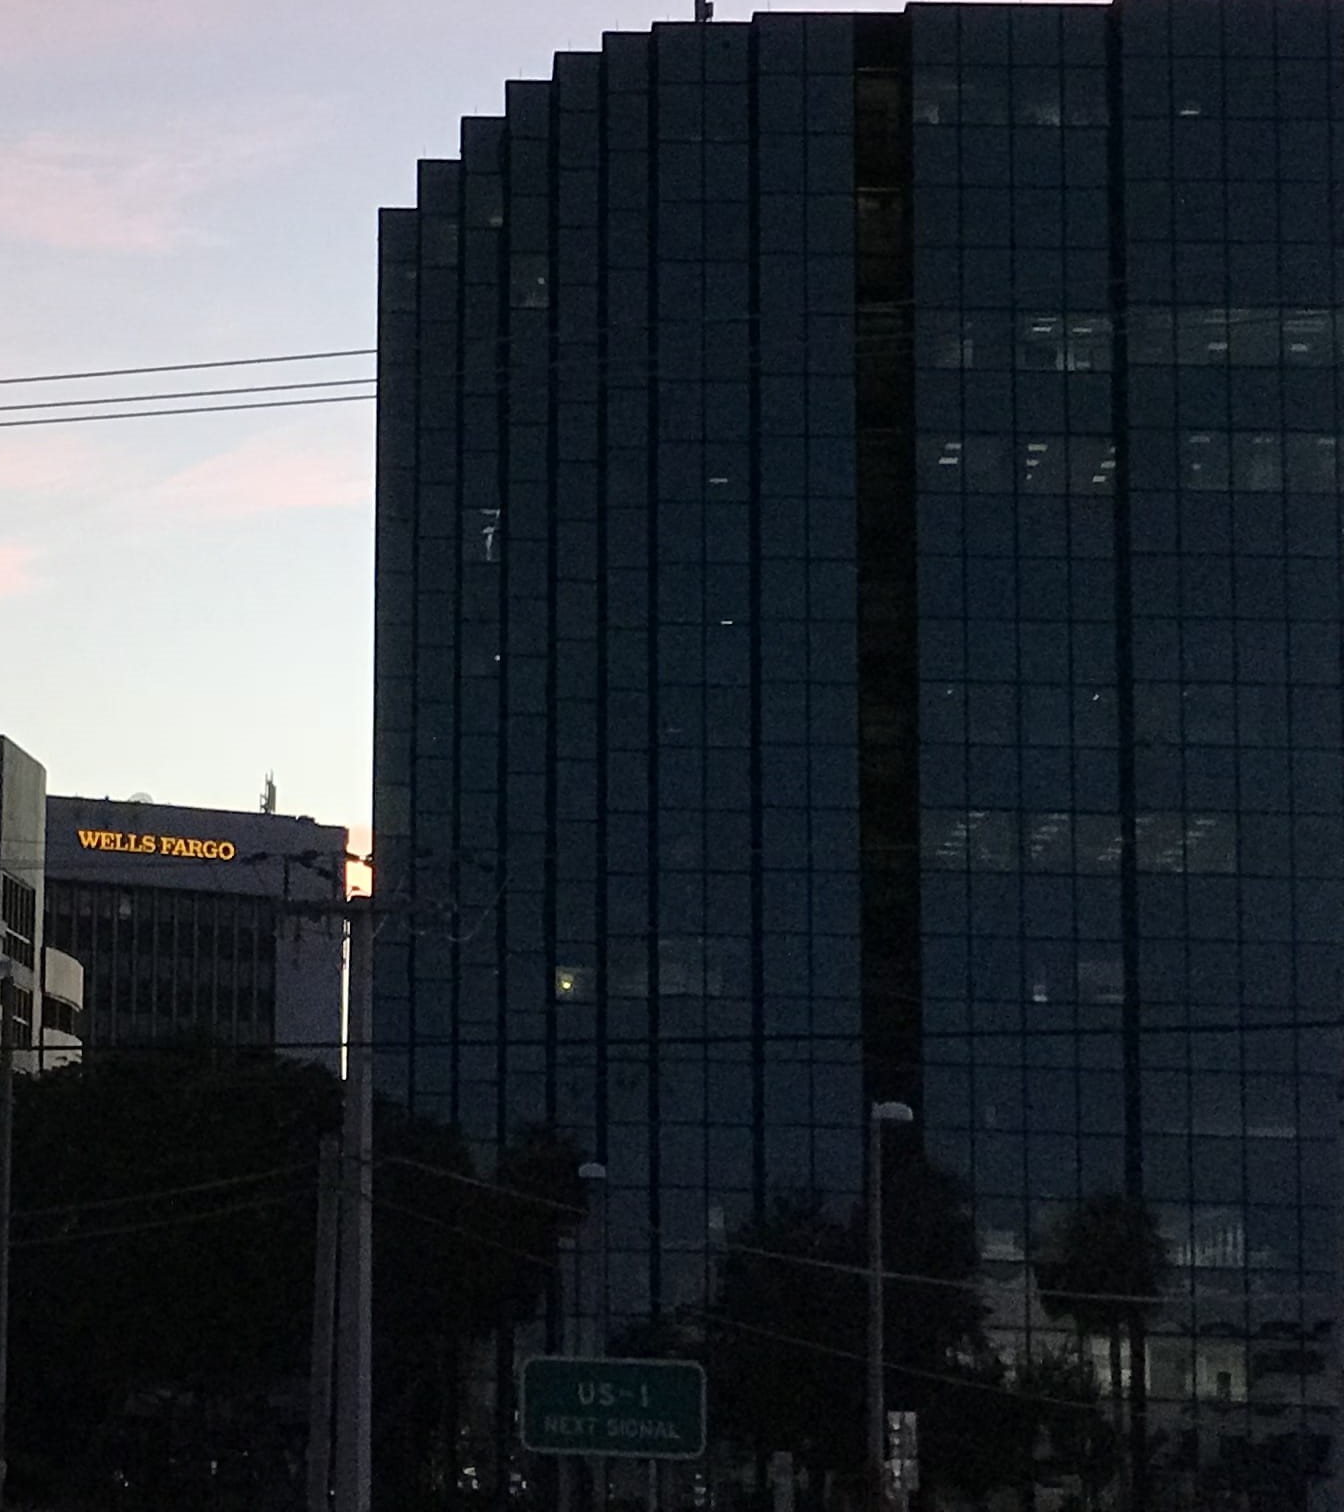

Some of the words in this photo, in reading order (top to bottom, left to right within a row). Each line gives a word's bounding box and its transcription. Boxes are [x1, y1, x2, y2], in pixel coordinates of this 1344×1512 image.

[77, 829, 157, 854] WELLS
[161, 836, 236, 861] FARGO
[577, 1381, 649, 1409] US-1
[543, 1414, 599, 1436] NEXT
[606, 1417, 681, 1441] SIGNAL
